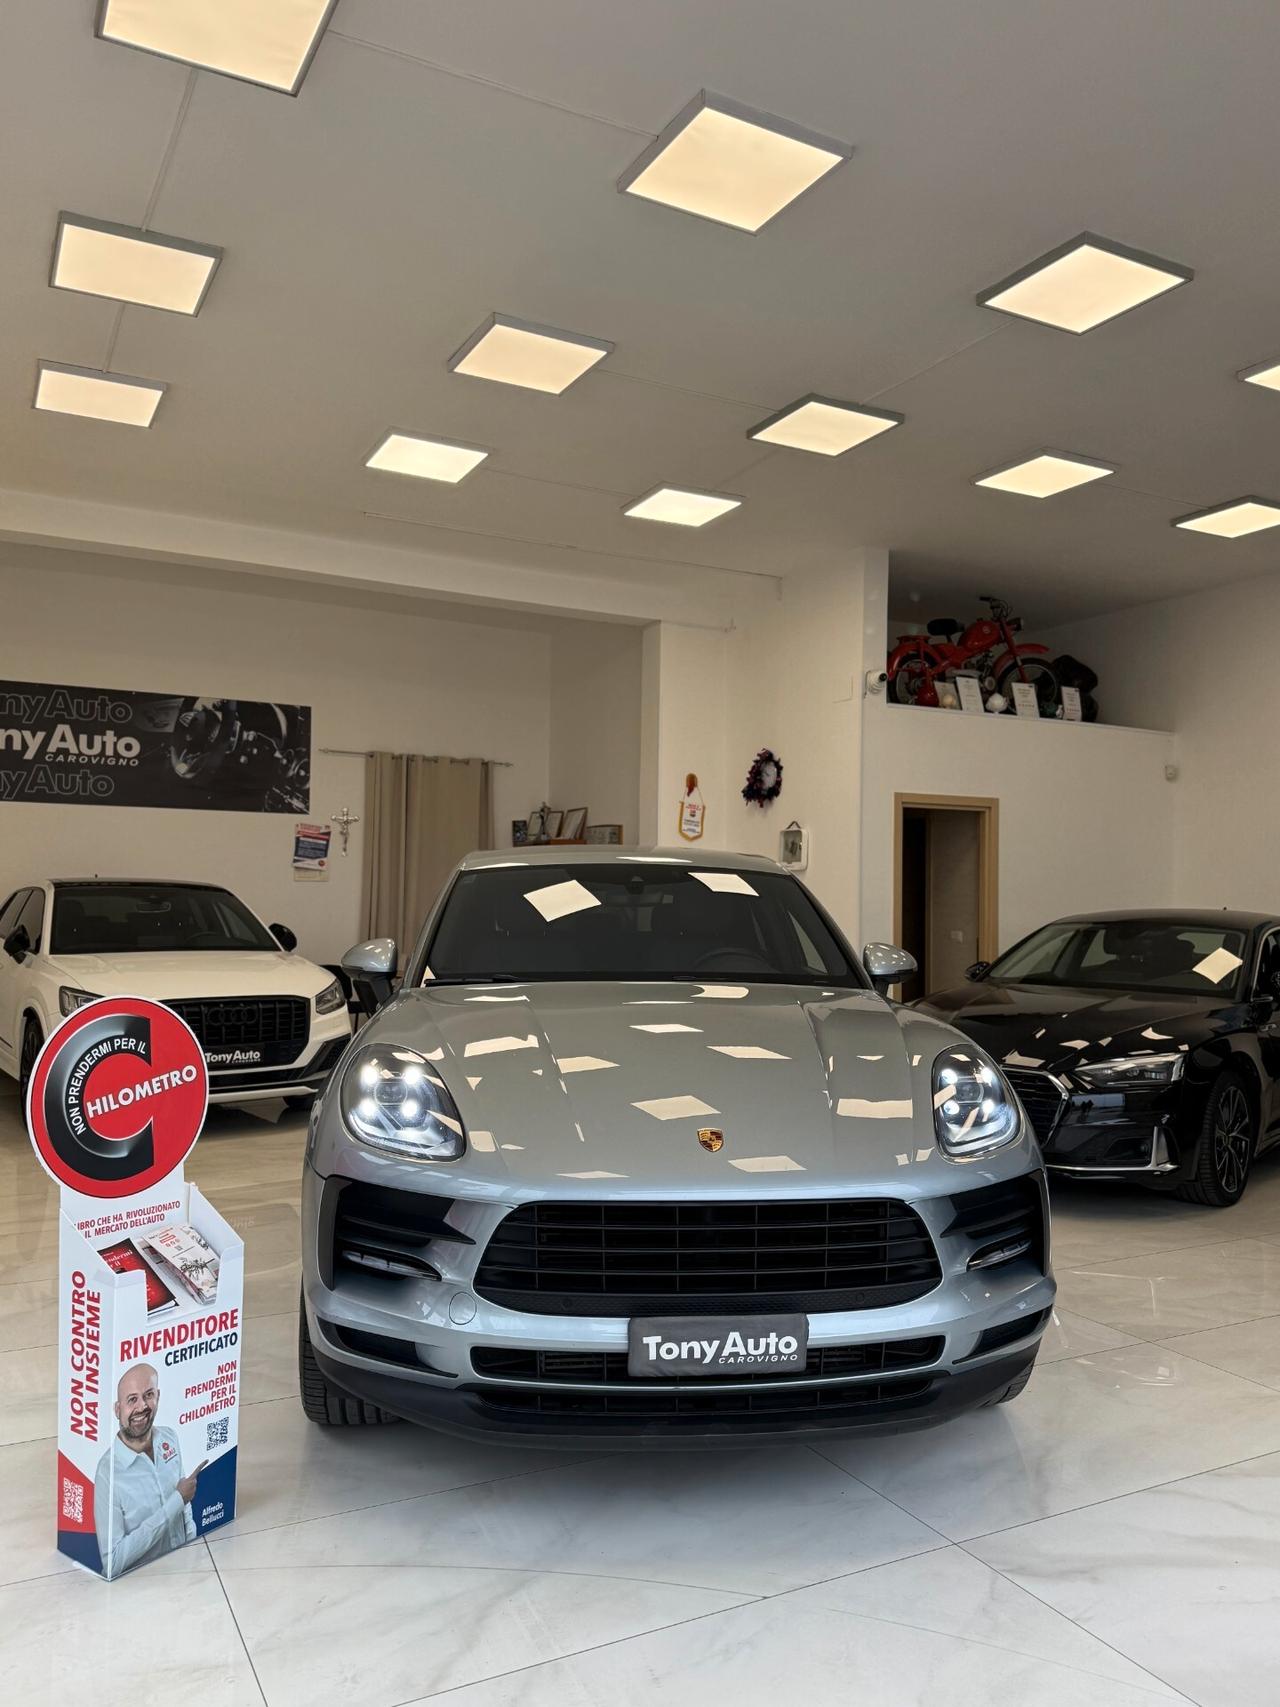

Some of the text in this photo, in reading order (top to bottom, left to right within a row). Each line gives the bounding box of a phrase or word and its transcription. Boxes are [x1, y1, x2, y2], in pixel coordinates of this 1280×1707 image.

[45, 753, 140, 767] CAROVIGNO
[68, 1037, 147, 1136] NON PRENDERMI PER IL
[86, 1064, 198, 1119] HILOMETRO
[74, 1200, 181, 1231] IBRO CHE HA RIVOLUZIONATO
[84, 1212, 166, 1239] IL MERCATO DELL'AUTO
[119, 1308, 240, 1363] RIVENDITORE
[164, 1331, 239, 1368] CERTIFICATO
[70, 1270, 87, 1436] NON CONTRO
[84, 1289, 101, 1442] MA INSIEME
[217, 1359, 238, 1376] NON
[718, 1354, 799, 1364] CAROVIGNO
[185, 1371, 237, 1399] PRENDERMI
[211, 1383, 237, 1402] PER IL
[179, 1395, 236, 1425] CHILOMETRO
[201, 1501, 224, 1518] Alfredo
[201, 1509, 225, 1527] Bellucci
